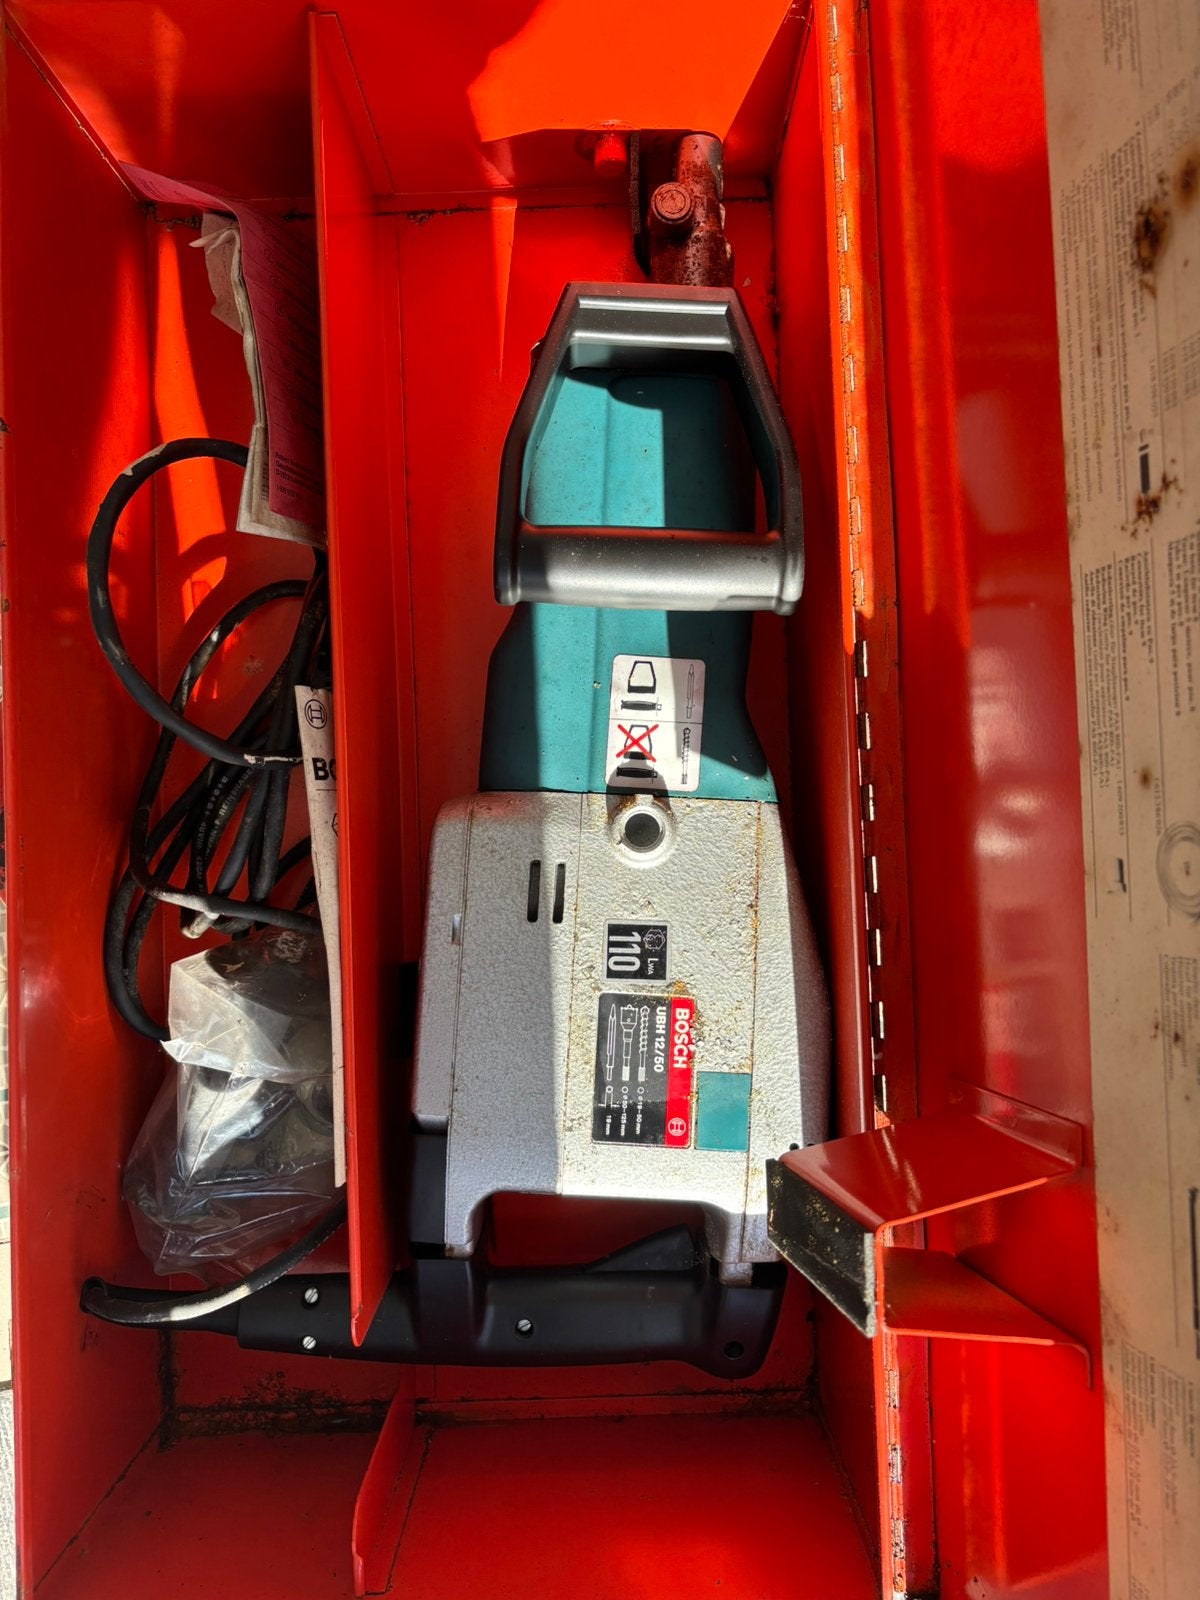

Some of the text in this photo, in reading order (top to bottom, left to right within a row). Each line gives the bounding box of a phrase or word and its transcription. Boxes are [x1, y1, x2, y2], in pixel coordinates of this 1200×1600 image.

[608, 932, 642, 972] 110
[654, 1006, 667, 1073] UBH 12/50
[673, 1008, 690, 1069] BOSCH
